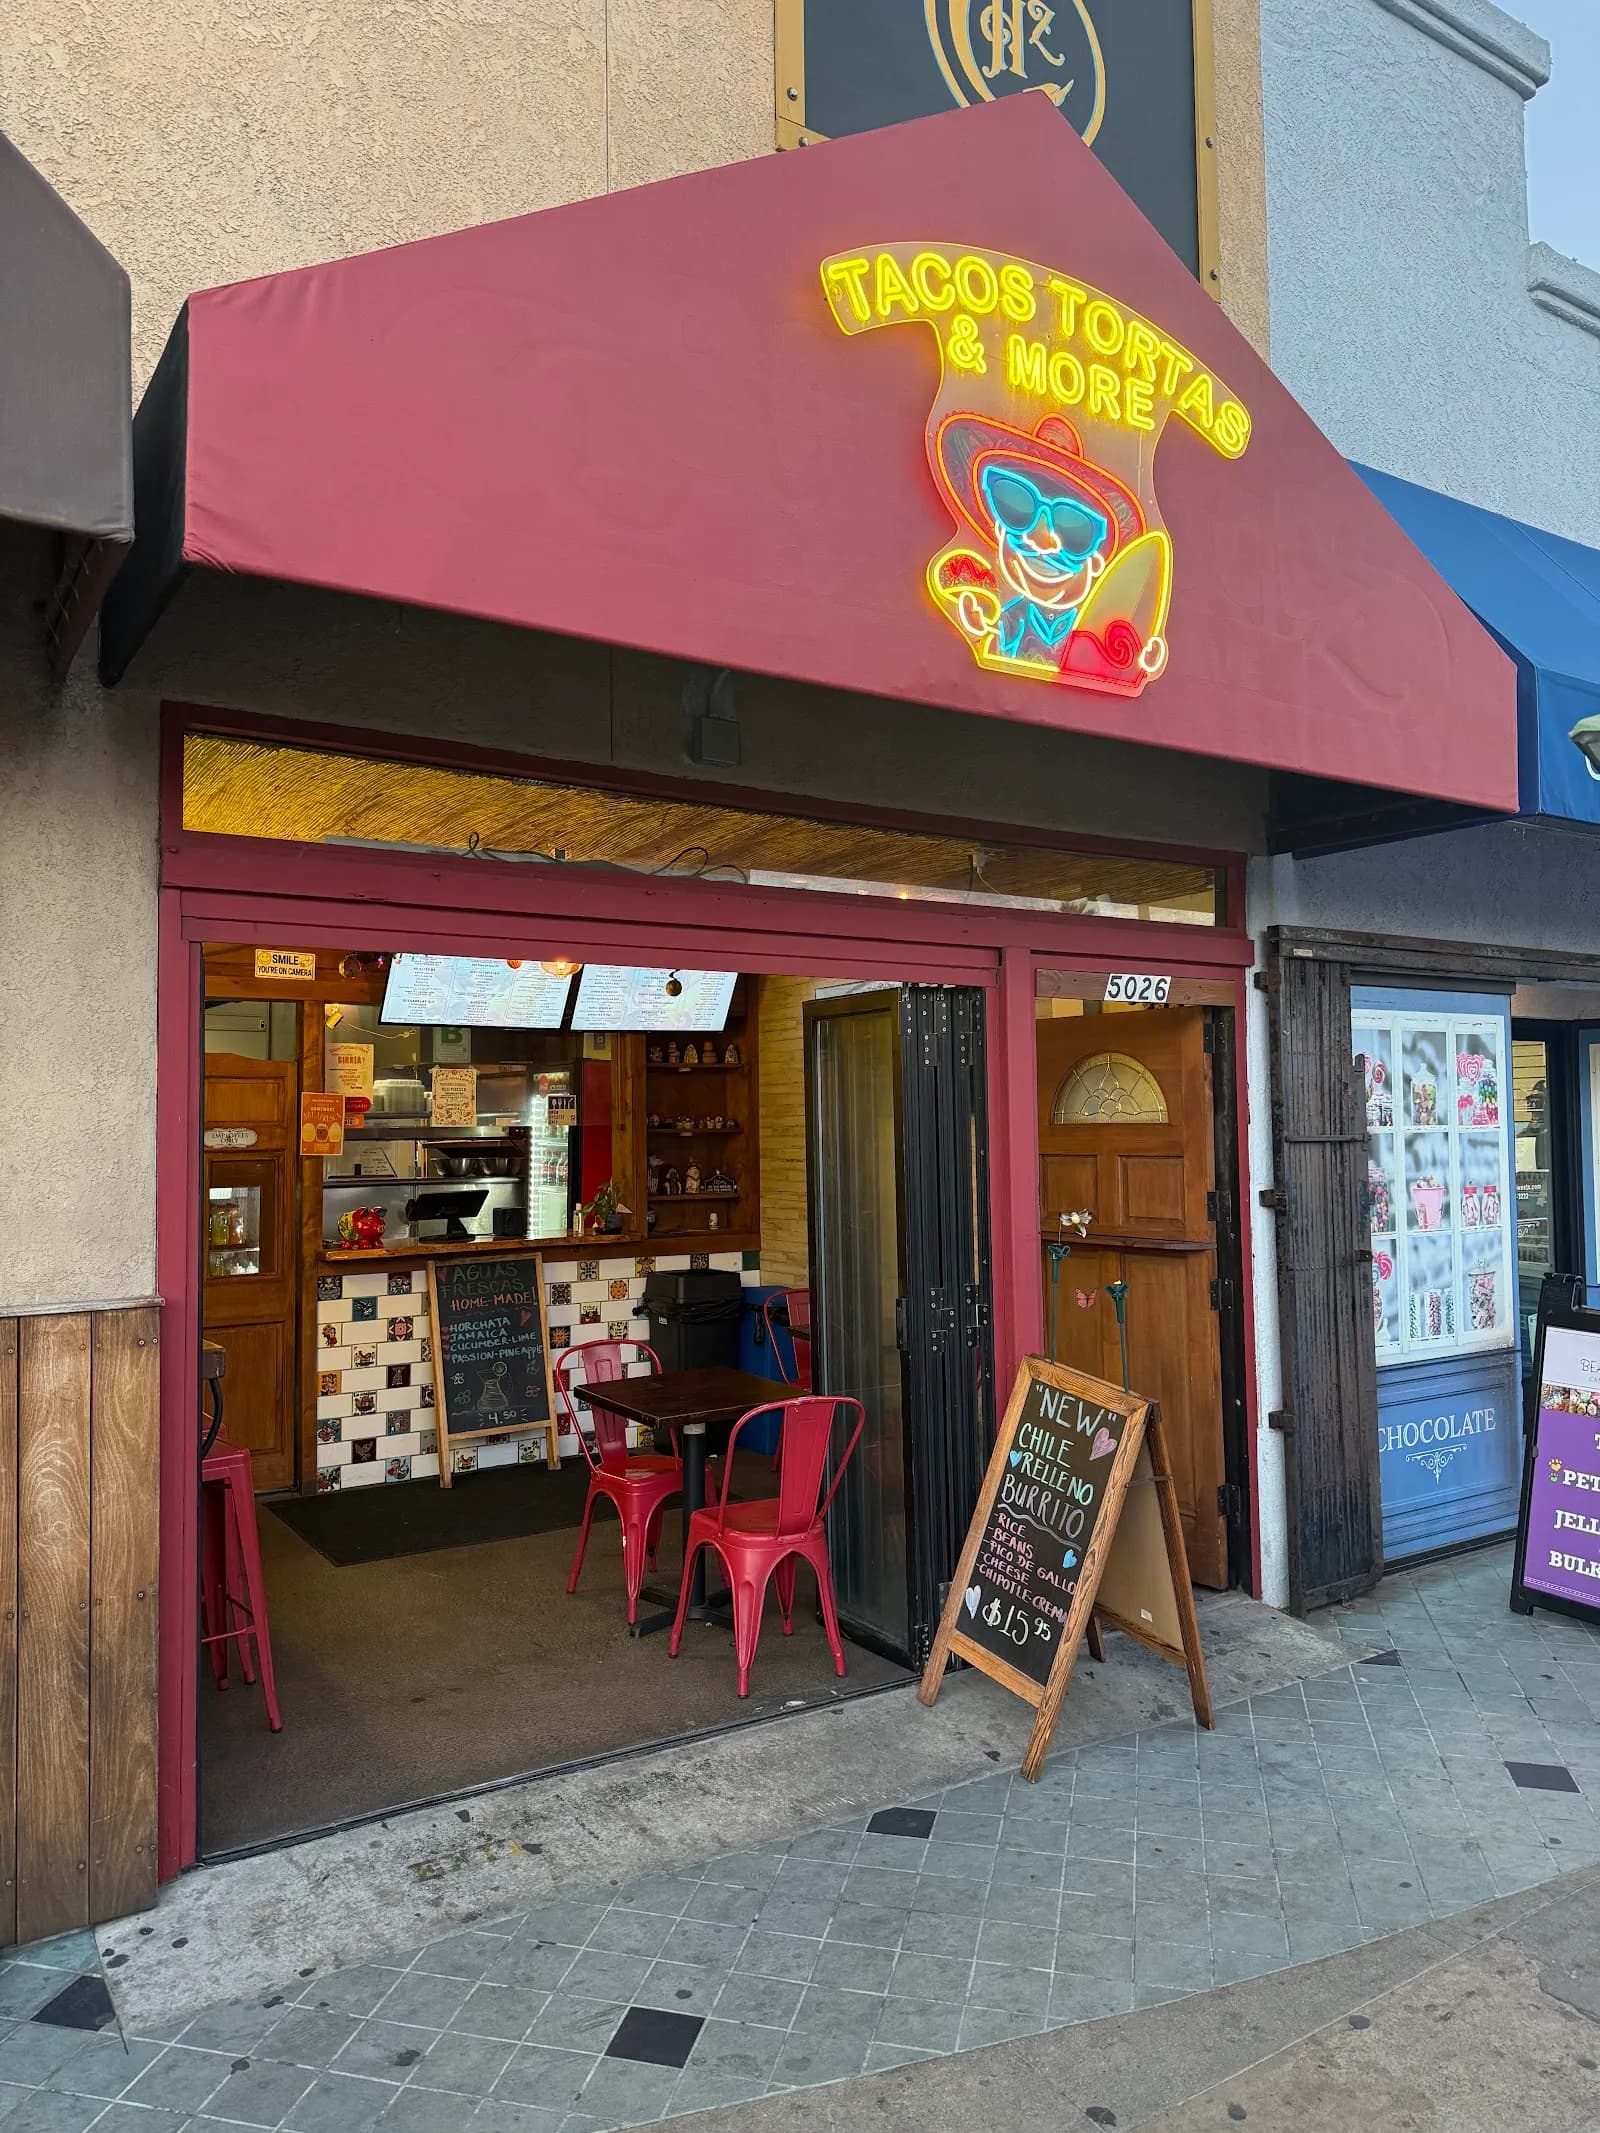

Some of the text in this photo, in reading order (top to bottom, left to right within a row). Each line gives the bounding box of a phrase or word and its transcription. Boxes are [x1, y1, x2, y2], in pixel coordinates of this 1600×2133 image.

[827, 252, 1249, 453] TACOS TORTAS
[947, 314, 1155, 431] & MORE
[258, 965, 312, 977] YOU'RE ON CAMERA
[272, 954, 299, 965] SMILE
[1108, 975, 1168, 1001] 5026
[441, 1026, 463, 1043] B
[452, 1262, 519, 1283] AGUAS
[440, 1279, 524, 1299] FRESCAS
[450, 1286, 538, 1312] HOME MADE!
[449, 1316, 511, 1334] HORCHATA
[449, 1327, 508, 1343] JAMAICA
[450, 1332, 537, 1352] CUCUMBER-LIME
[488, 1410, 518, 1425] 4.50
[1378, 1407, 1497, 1453] CHOCOLATE
[1018, 1422, 1075, 1468] CHILE
[1020, 1451, 1094, 1506] RELLENO
[1001, 1473, 1085, 1539] BURRITO
[1015, 1555, 1036, 1572] DE
[1036, 1567, 1077, 1596] GALLO
[1548, 1549, 1600, 1579] BULK
